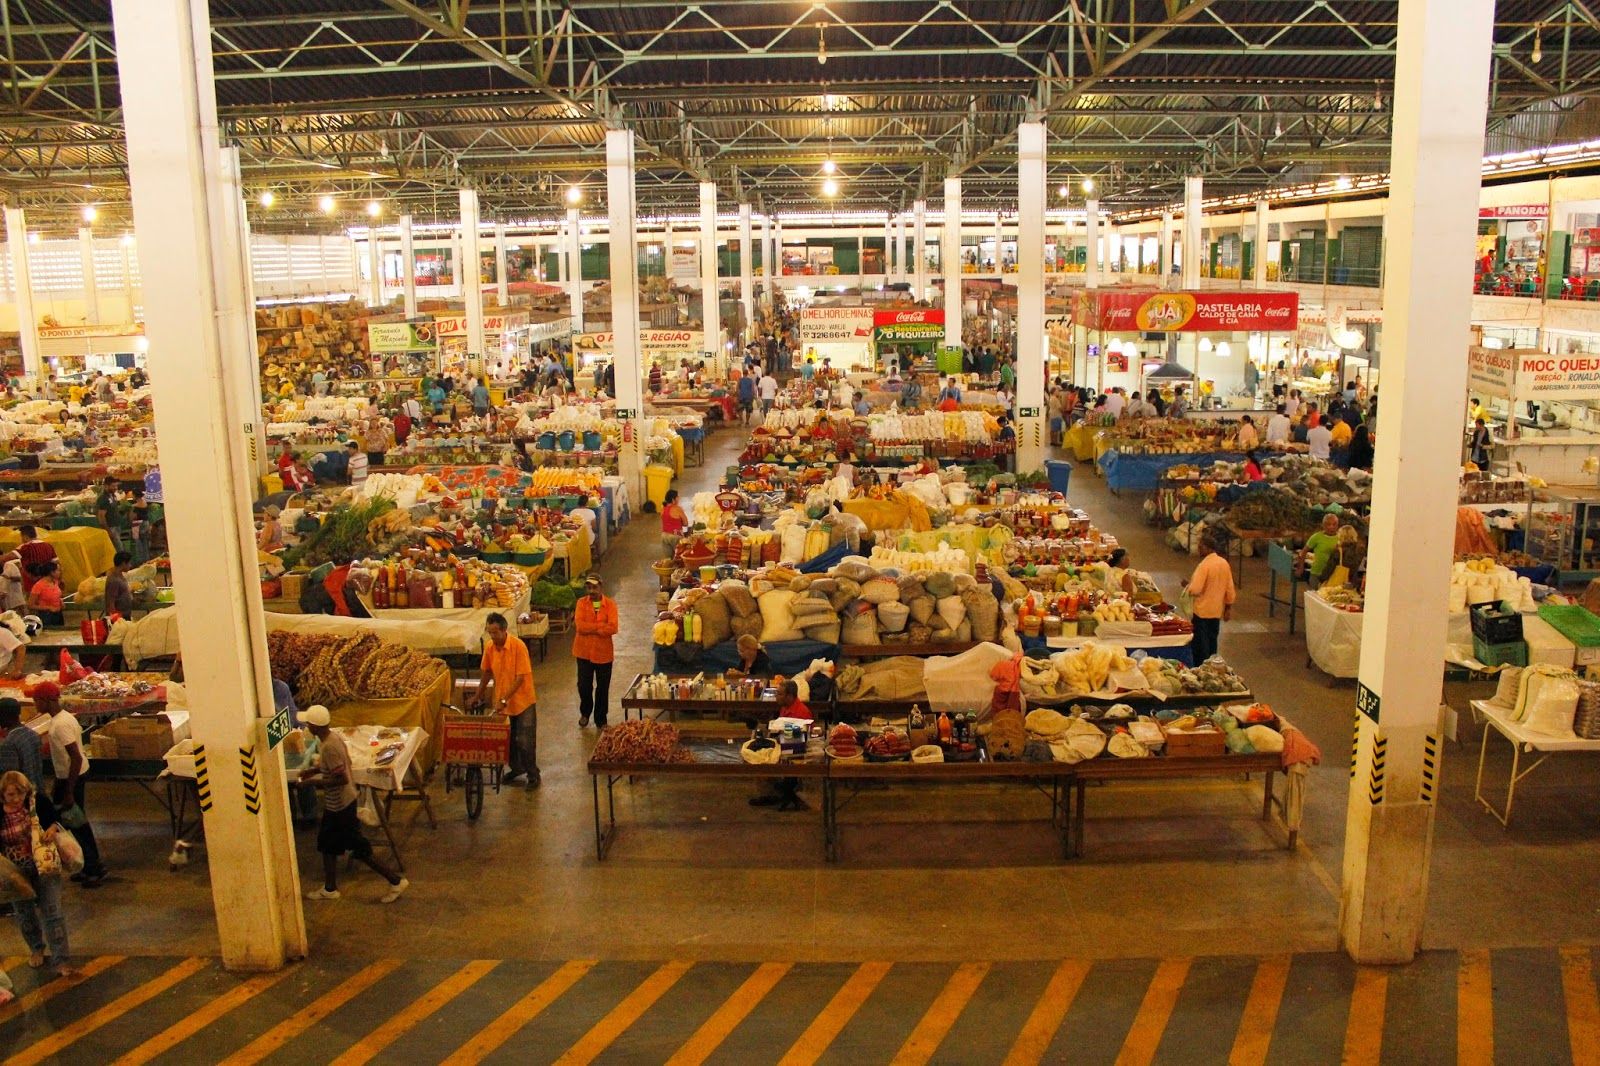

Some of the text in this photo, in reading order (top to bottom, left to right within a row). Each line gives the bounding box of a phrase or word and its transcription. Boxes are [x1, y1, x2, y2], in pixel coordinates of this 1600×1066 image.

[1197, 304, 1262, 312] PASTELARIA
[440, 321, 455, 331] DU
[1523, 360, 1555, 372] MOC
[1568, 372, 1600, 382] RONALD
